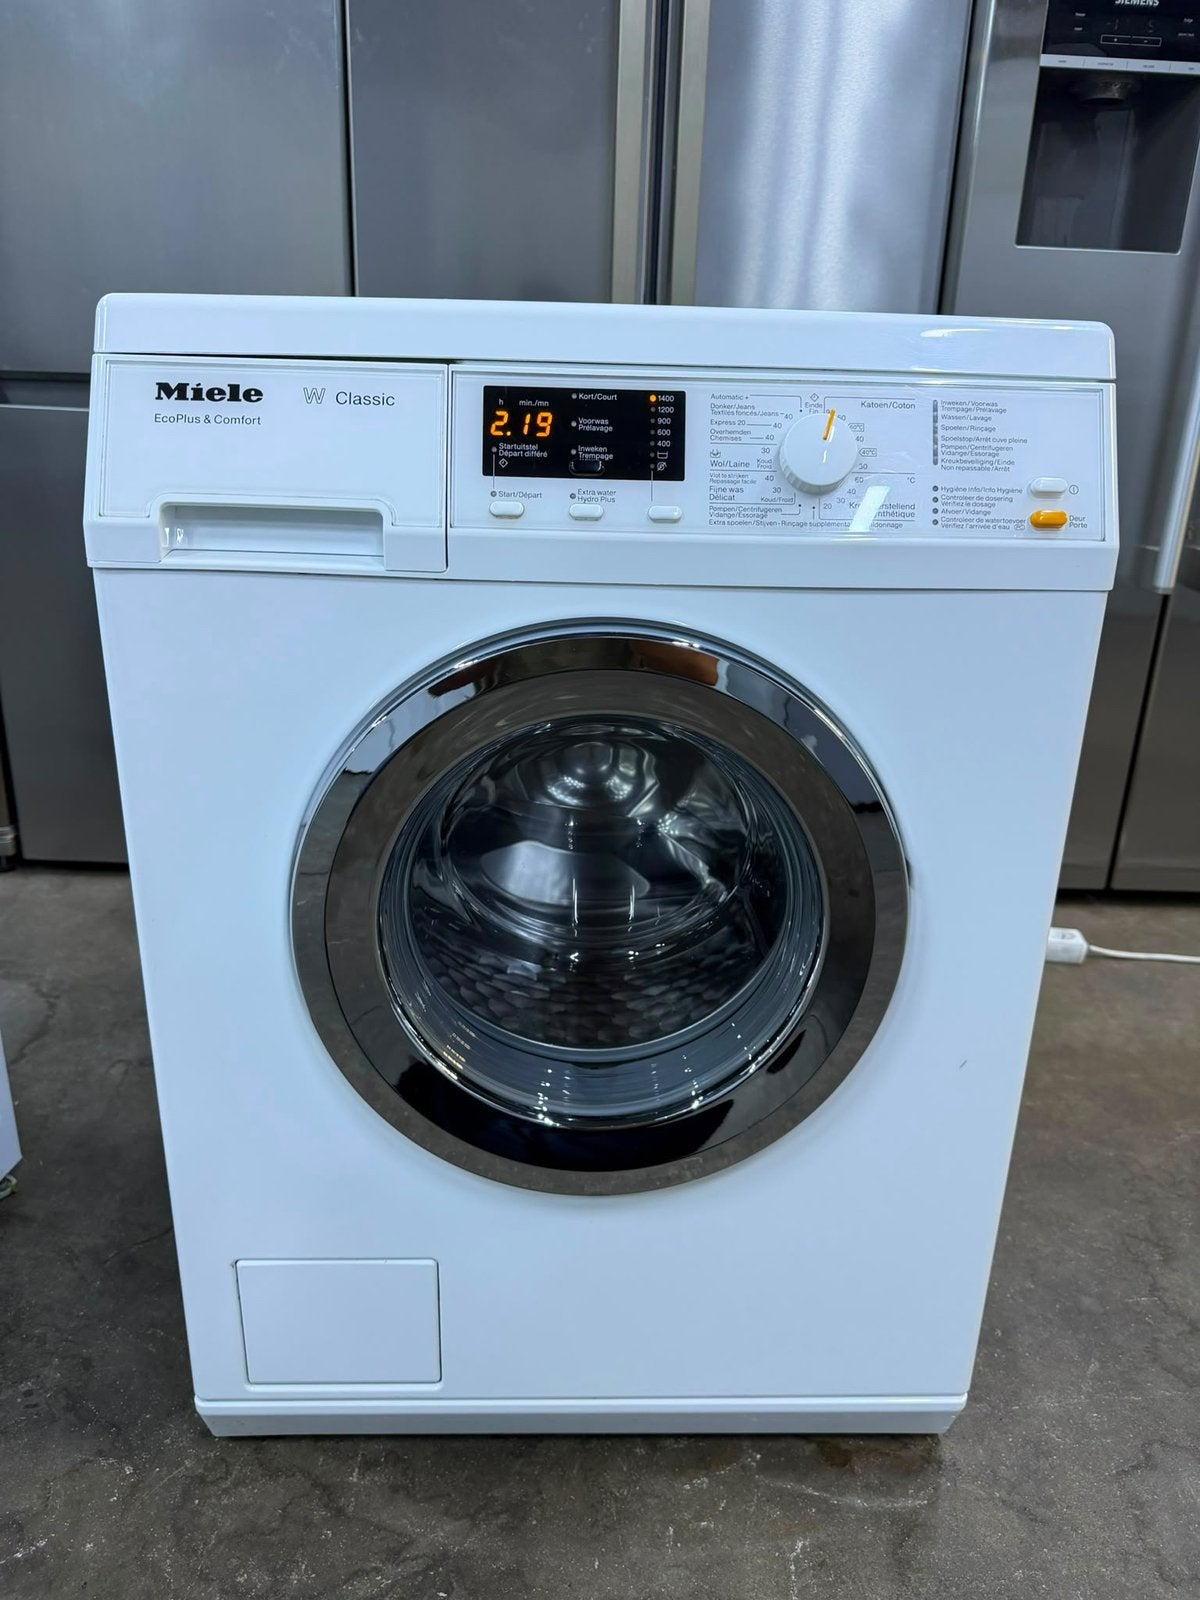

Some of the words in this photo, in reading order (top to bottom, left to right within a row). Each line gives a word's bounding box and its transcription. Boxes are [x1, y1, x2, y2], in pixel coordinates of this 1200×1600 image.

[155, 382, 263, 403] Miele
[303, 387, 326, 404] W
[335, 391, 395, 407] Classic
[578, 393, 618, 401] Kort/Court
[710, 402, 755, 410] Donker/Jeans
[860, 400, 916, 410] Katoen/Coton
[154, 413, 201, 424] EcoPlus
[203, 414, 211, 424] &
[214, 414, 261, 425] Comfort
[578, 417, 609, 425] Voorwas
[490, 410, 553, 437] 2.19
[578, 424, 613, 433] Prélavage
[499, 442, 538, 450] Startuitstel
[578, 445, 608, 453] Inweken
[499, 450, 523, 458] Départ
[524, 450, 548, 458] différé
[578, 452, 614, 460] Trempage
[710, 460, 750, 468] Wol/Laine
[709, 485, 728, 494] Fijne
[772, 486, 782, 494] 30
[498, 490, 542, 500] Start/Départ
[709, 493, 735, 501] Délicat
[577, 496, 599, 504] Hydro
